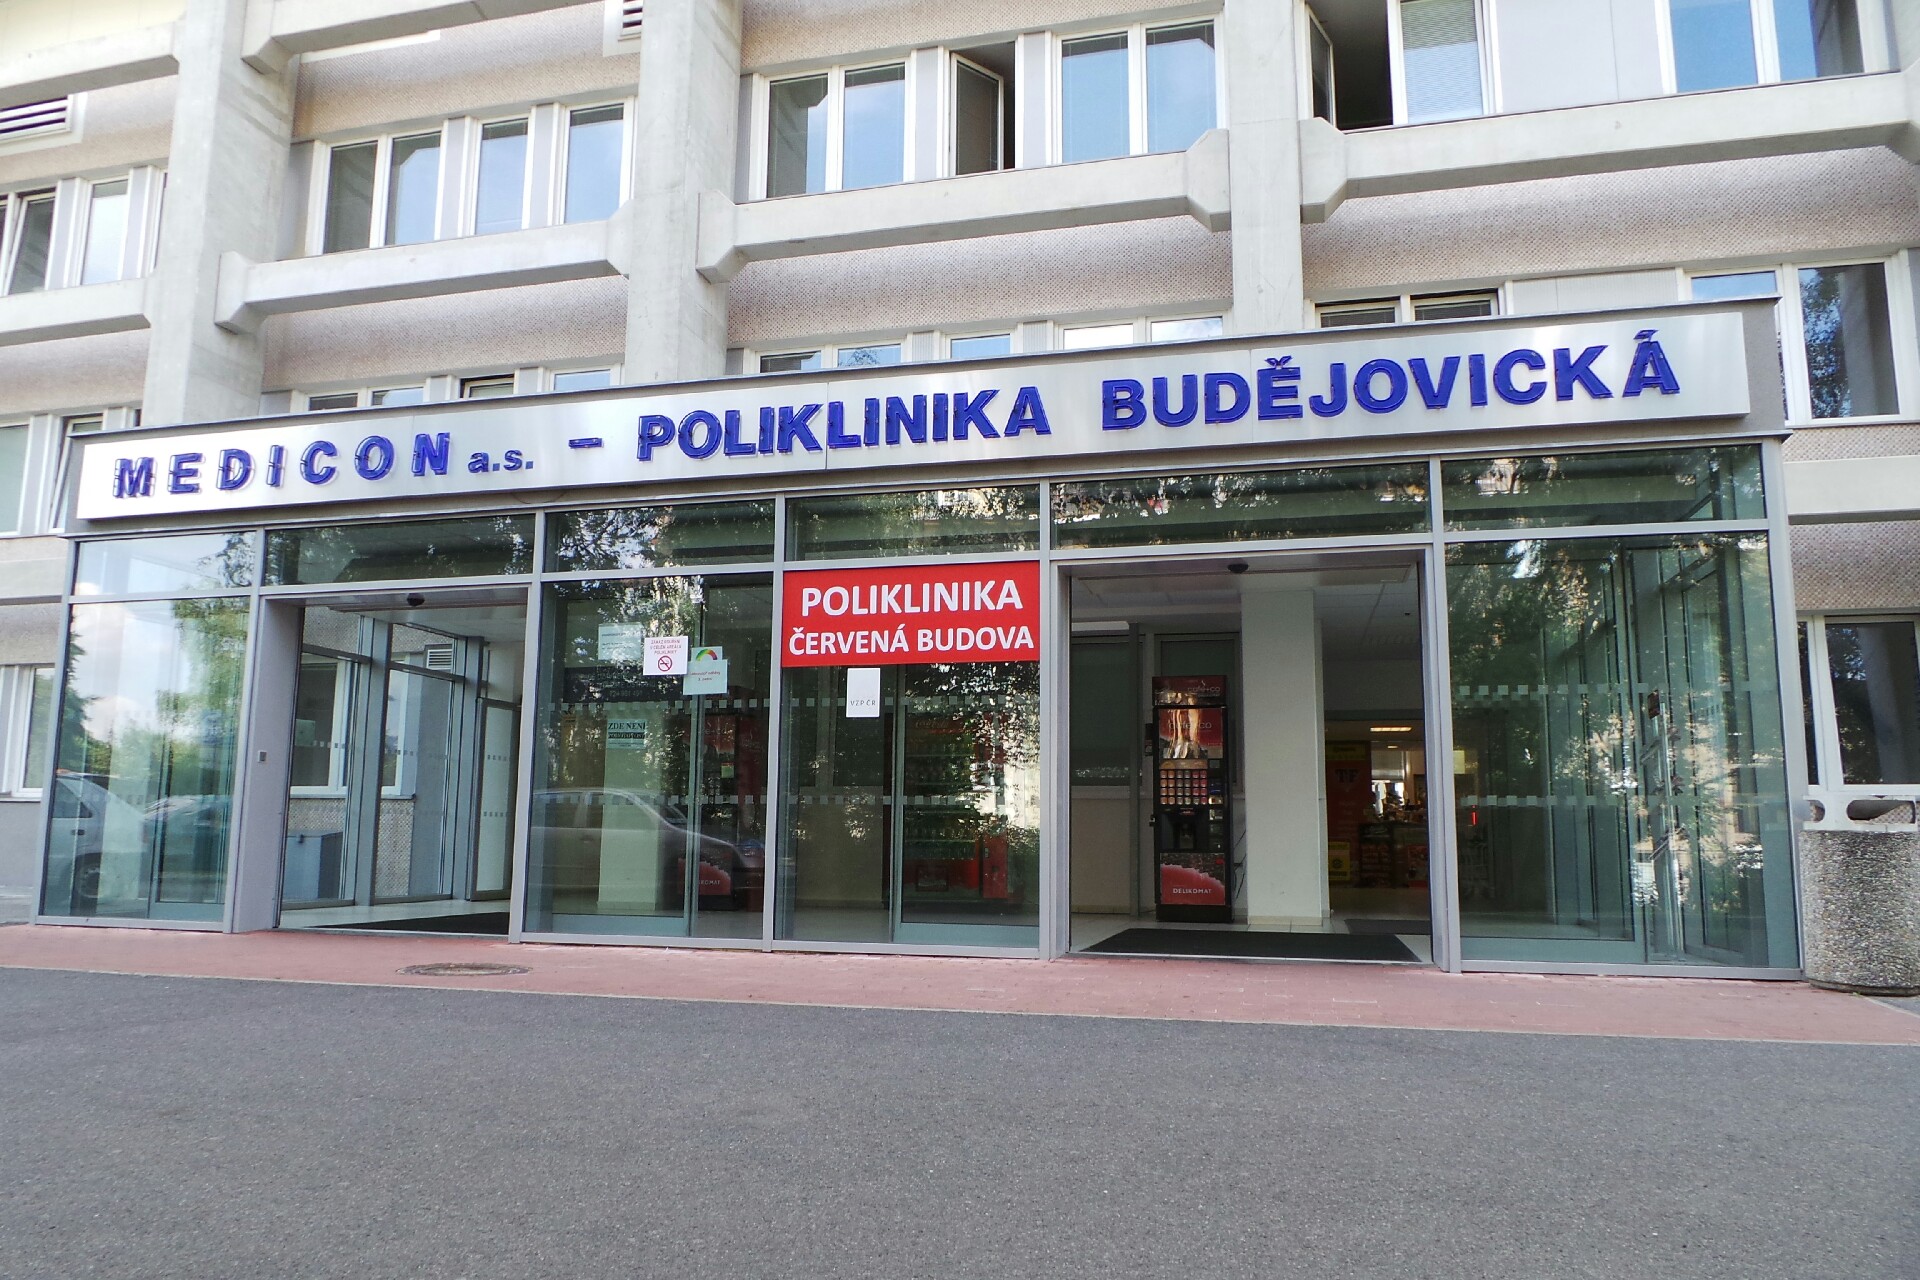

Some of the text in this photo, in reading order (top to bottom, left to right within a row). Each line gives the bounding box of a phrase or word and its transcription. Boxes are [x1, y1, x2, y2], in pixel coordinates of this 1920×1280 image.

[112, 430, 451, 499] MEDICON
[467, 446, 535, 474] a.s.
[636, 386, 1052, 463] POLIKLINIKA
[1101, 329, 1680, 431] BUDĚJOVICKÁ
[801, 579, 1024, 617] POLIKLINIKA
[788, 624, 1035, 656] ČERVENÁ BUDOVA
[866, 698, 876, 706] ČR
[608, 722, 625, 730] ZDE
